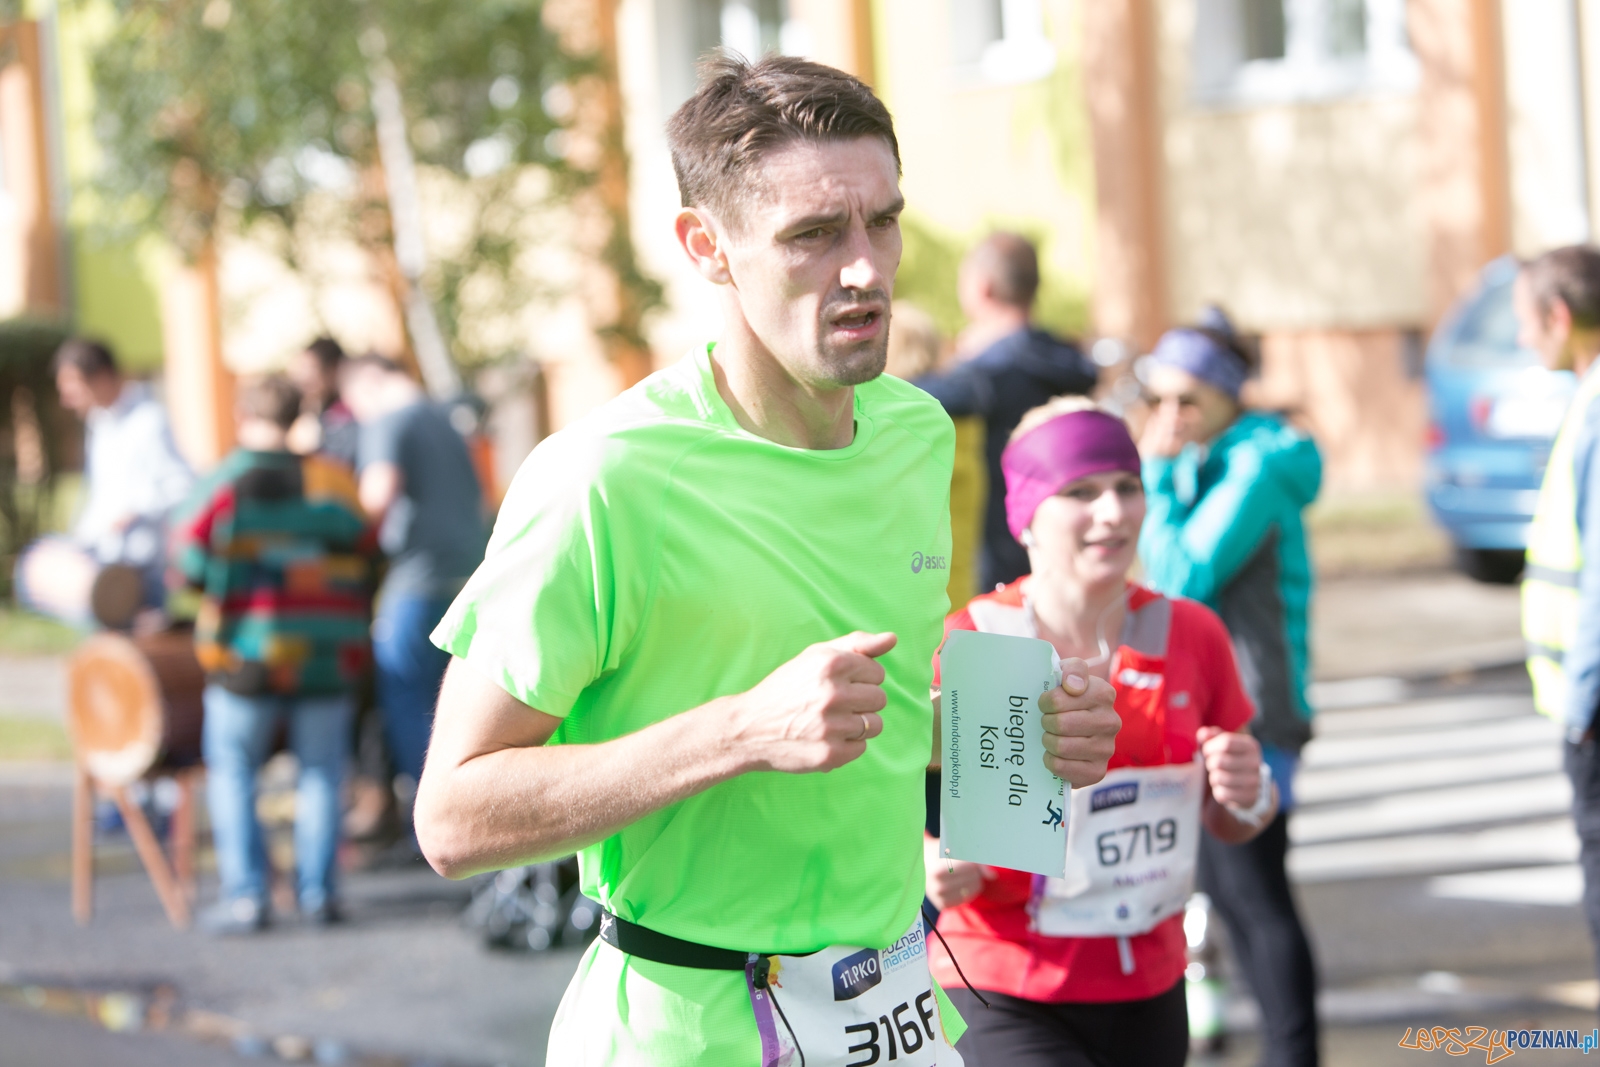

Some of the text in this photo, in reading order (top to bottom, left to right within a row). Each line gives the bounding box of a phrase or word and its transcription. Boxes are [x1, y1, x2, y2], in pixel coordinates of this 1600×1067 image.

[925, 555, 946, 570] asics
[951, 689, 961, 799] www.fundacjapkobp.pl
[980, 725, 999, 770] Kasi
[1004, 695, 1029, 807] biegnę dla
[1096, 817, 1177, 868] 6719
[882, 941, 926, 971] maraton
